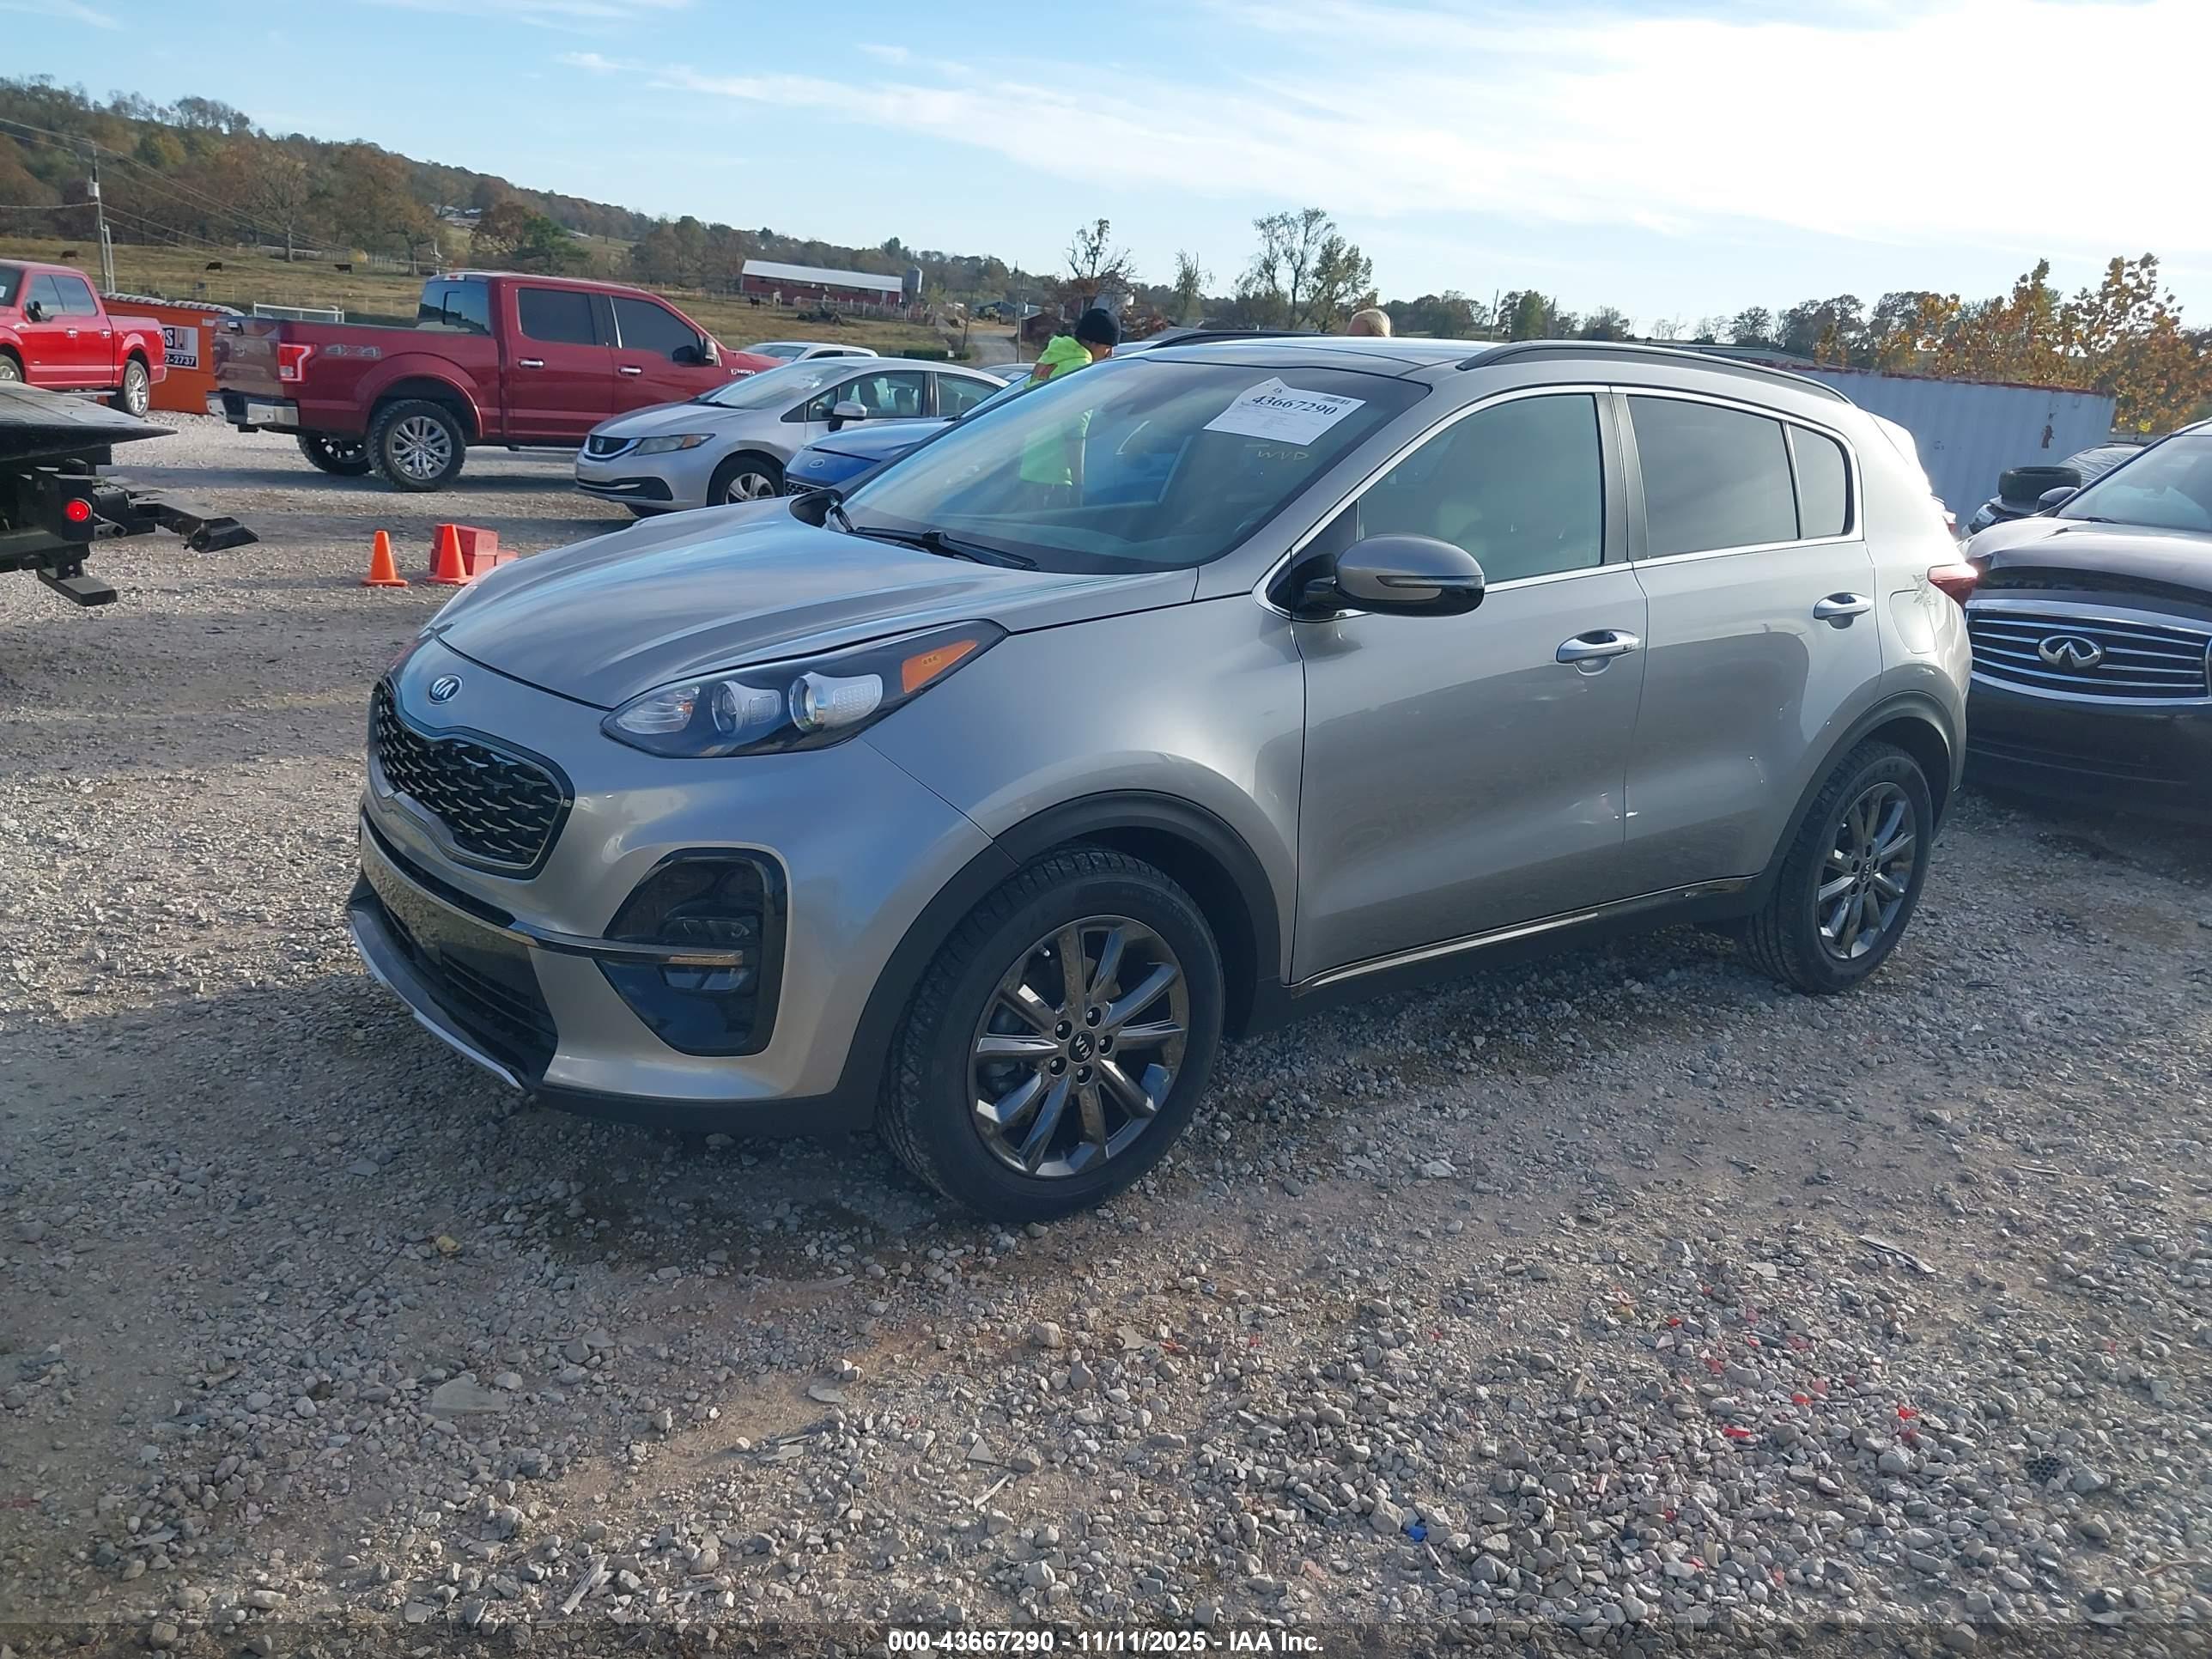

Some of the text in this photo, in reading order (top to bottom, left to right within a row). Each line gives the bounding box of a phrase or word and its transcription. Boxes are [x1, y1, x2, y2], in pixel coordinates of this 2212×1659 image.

[1252, 395, 1338, 416] 43667290
[433, 678, 455, 698] KIA
[1076, 1035, 1091, 1059] KIA
